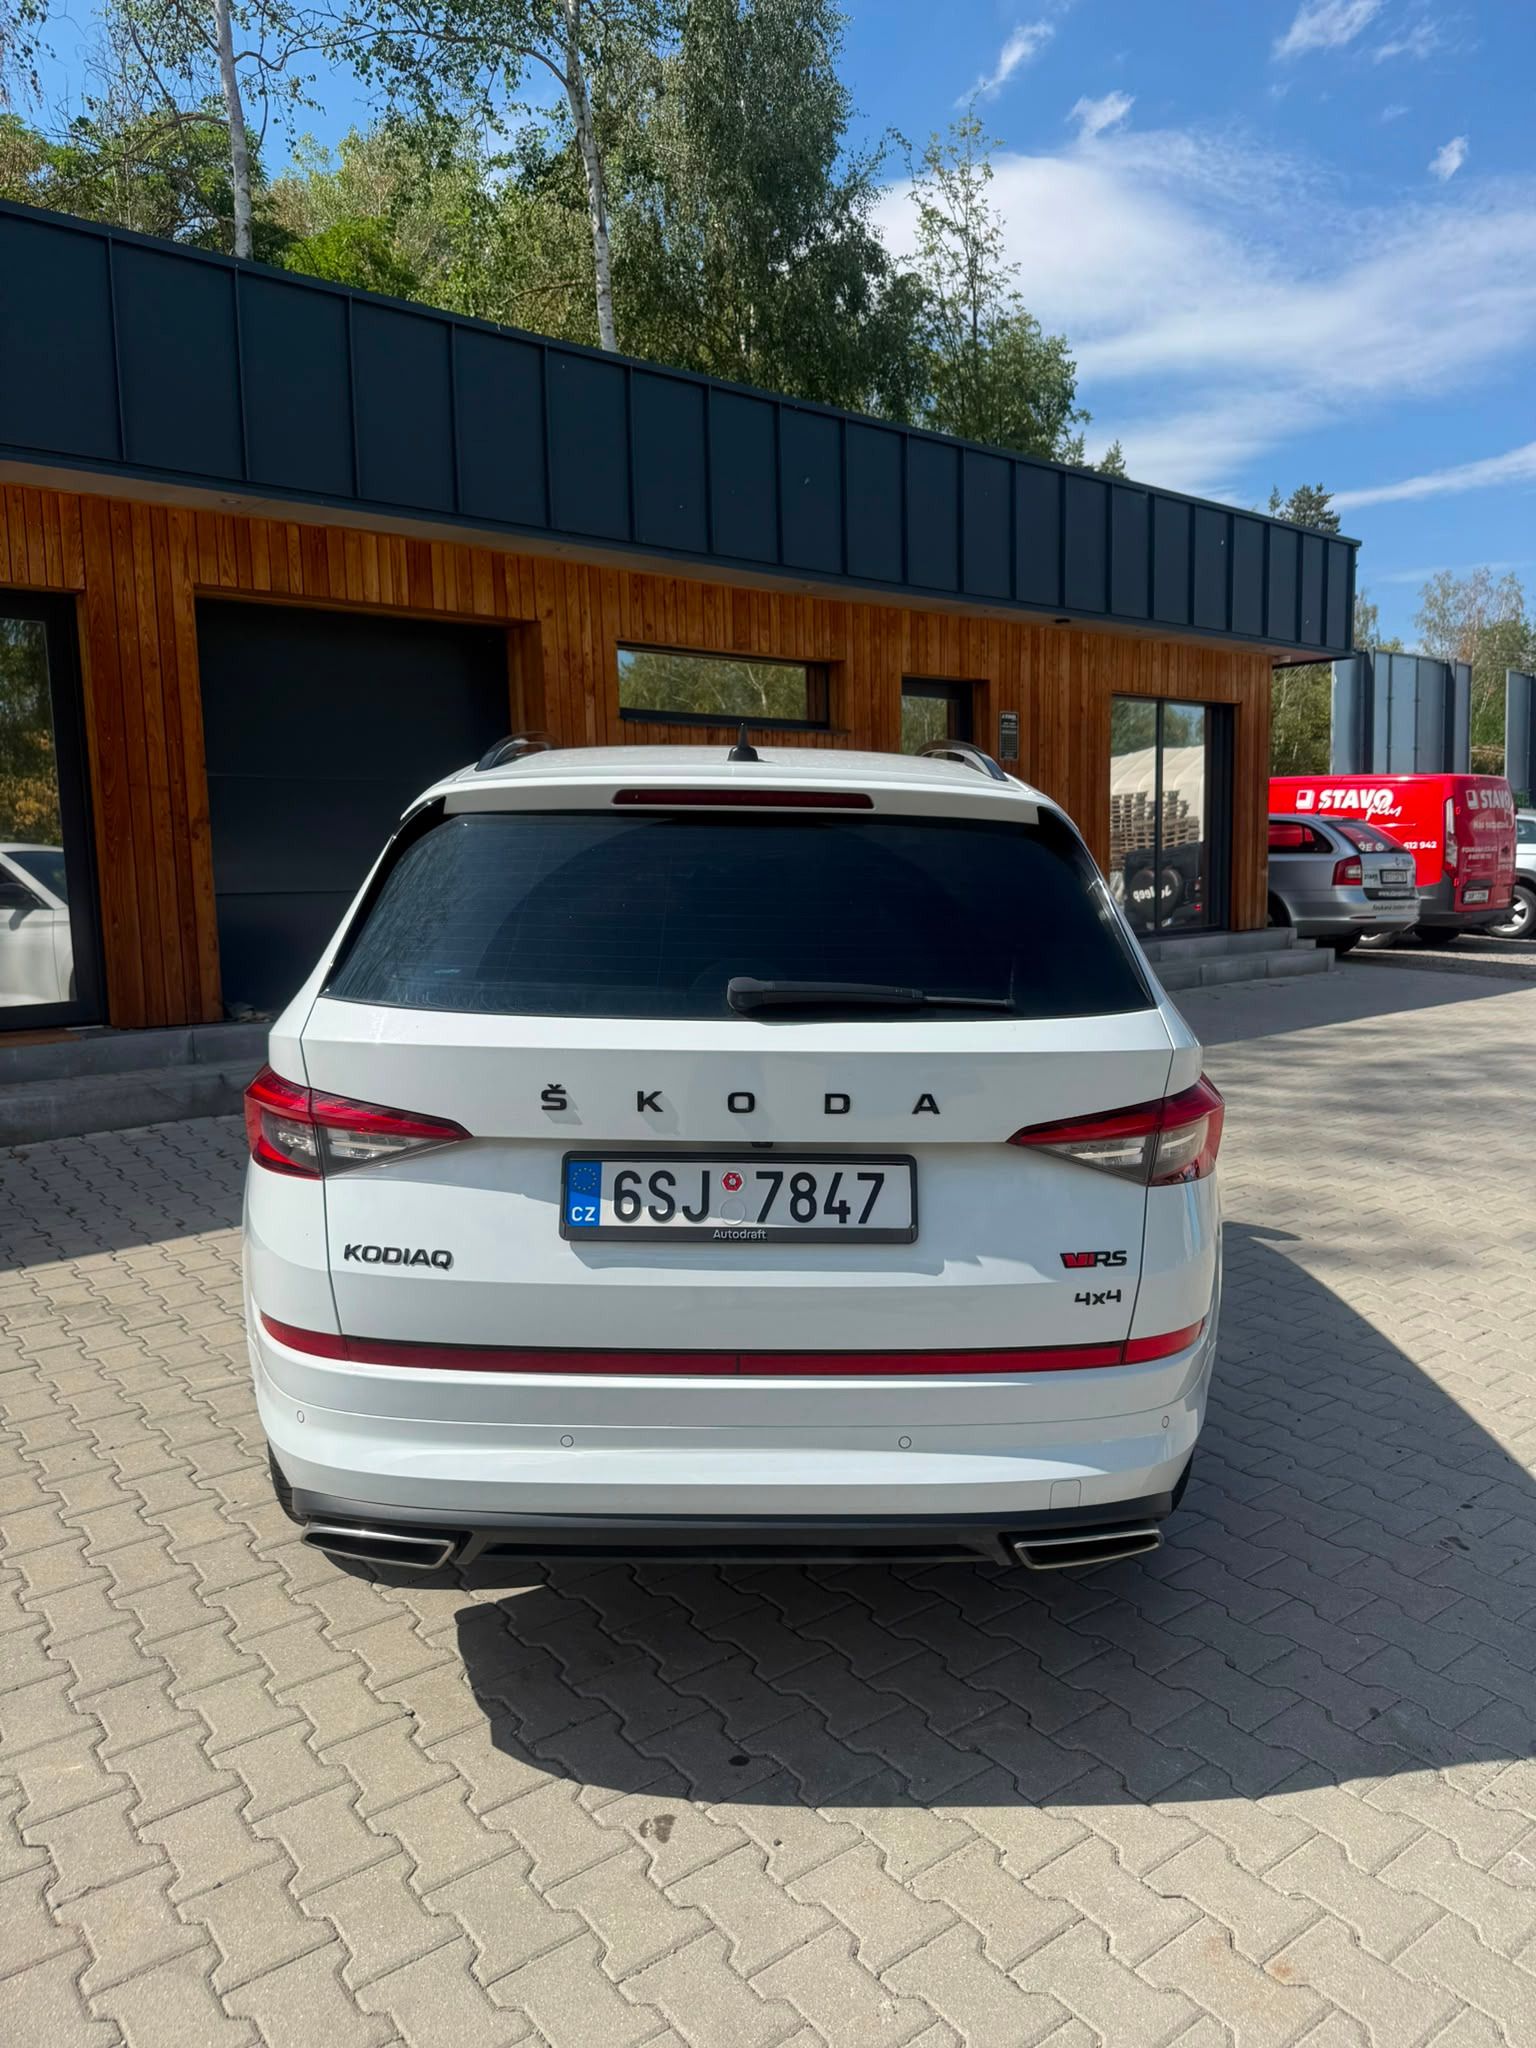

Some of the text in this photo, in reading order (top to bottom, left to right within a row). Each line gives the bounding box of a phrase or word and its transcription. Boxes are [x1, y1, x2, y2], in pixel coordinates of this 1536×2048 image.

[1318, 789, 1393, 809] STAVO
[541, 1084, 940, 1115] ŠKODA
[613, 1170, 885, 1224] 6SJ 7847
[571, 1206, 595, 1222] CZ
[713, 1229, 767, 1240] Autodraft
[344, 1244, 453, 1271] KODIAQ
[1074, 1289, 1122, 1305] 4x4
